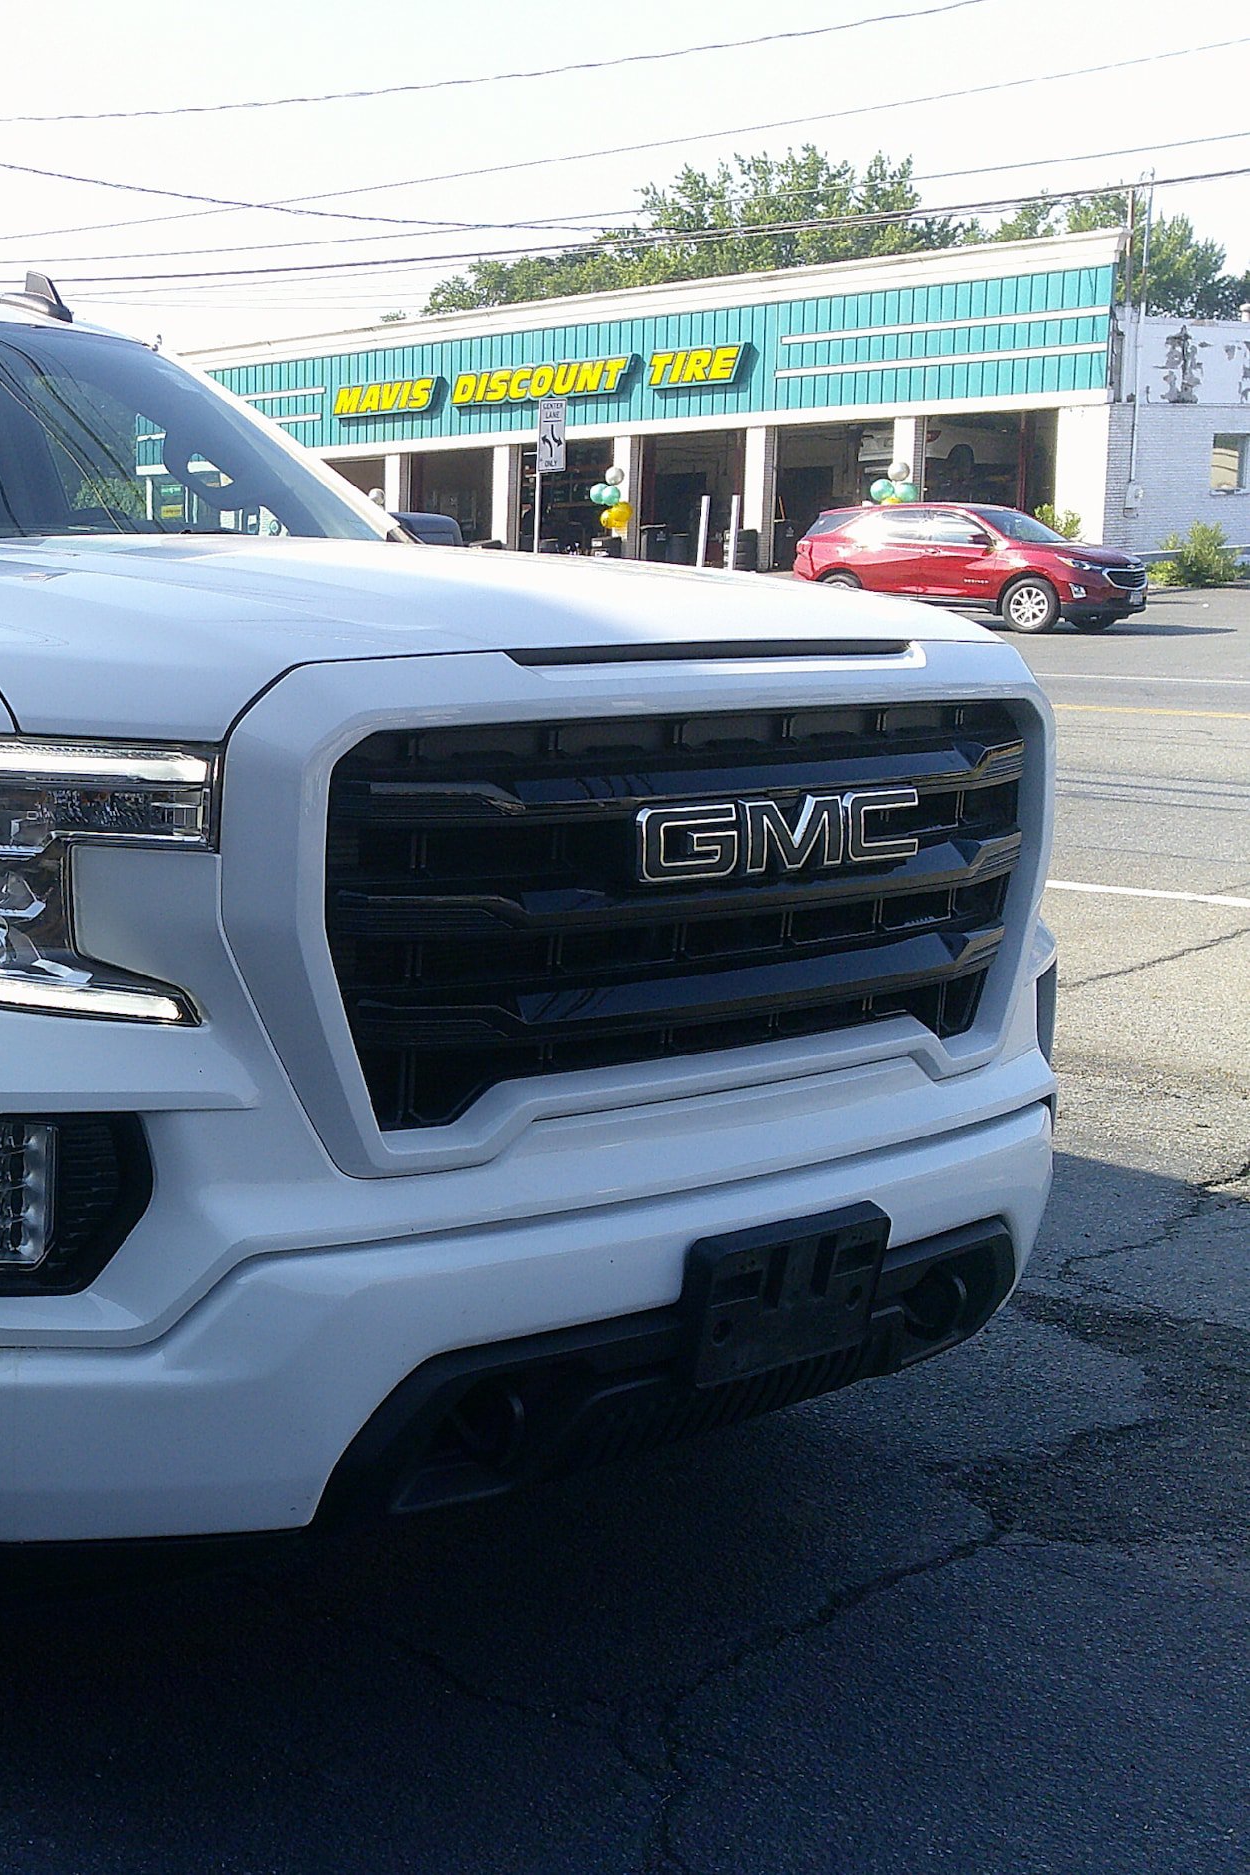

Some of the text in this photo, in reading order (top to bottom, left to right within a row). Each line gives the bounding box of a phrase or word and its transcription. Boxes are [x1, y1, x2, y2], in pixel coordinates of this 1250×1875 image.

[333, 345, 739, 415] MAVIS DISCOUNT TIRE
[543, 402, 563, 410] CENTER
[545, 411, 560, 419] LANE
[637, 787, 920, 883] GMC
